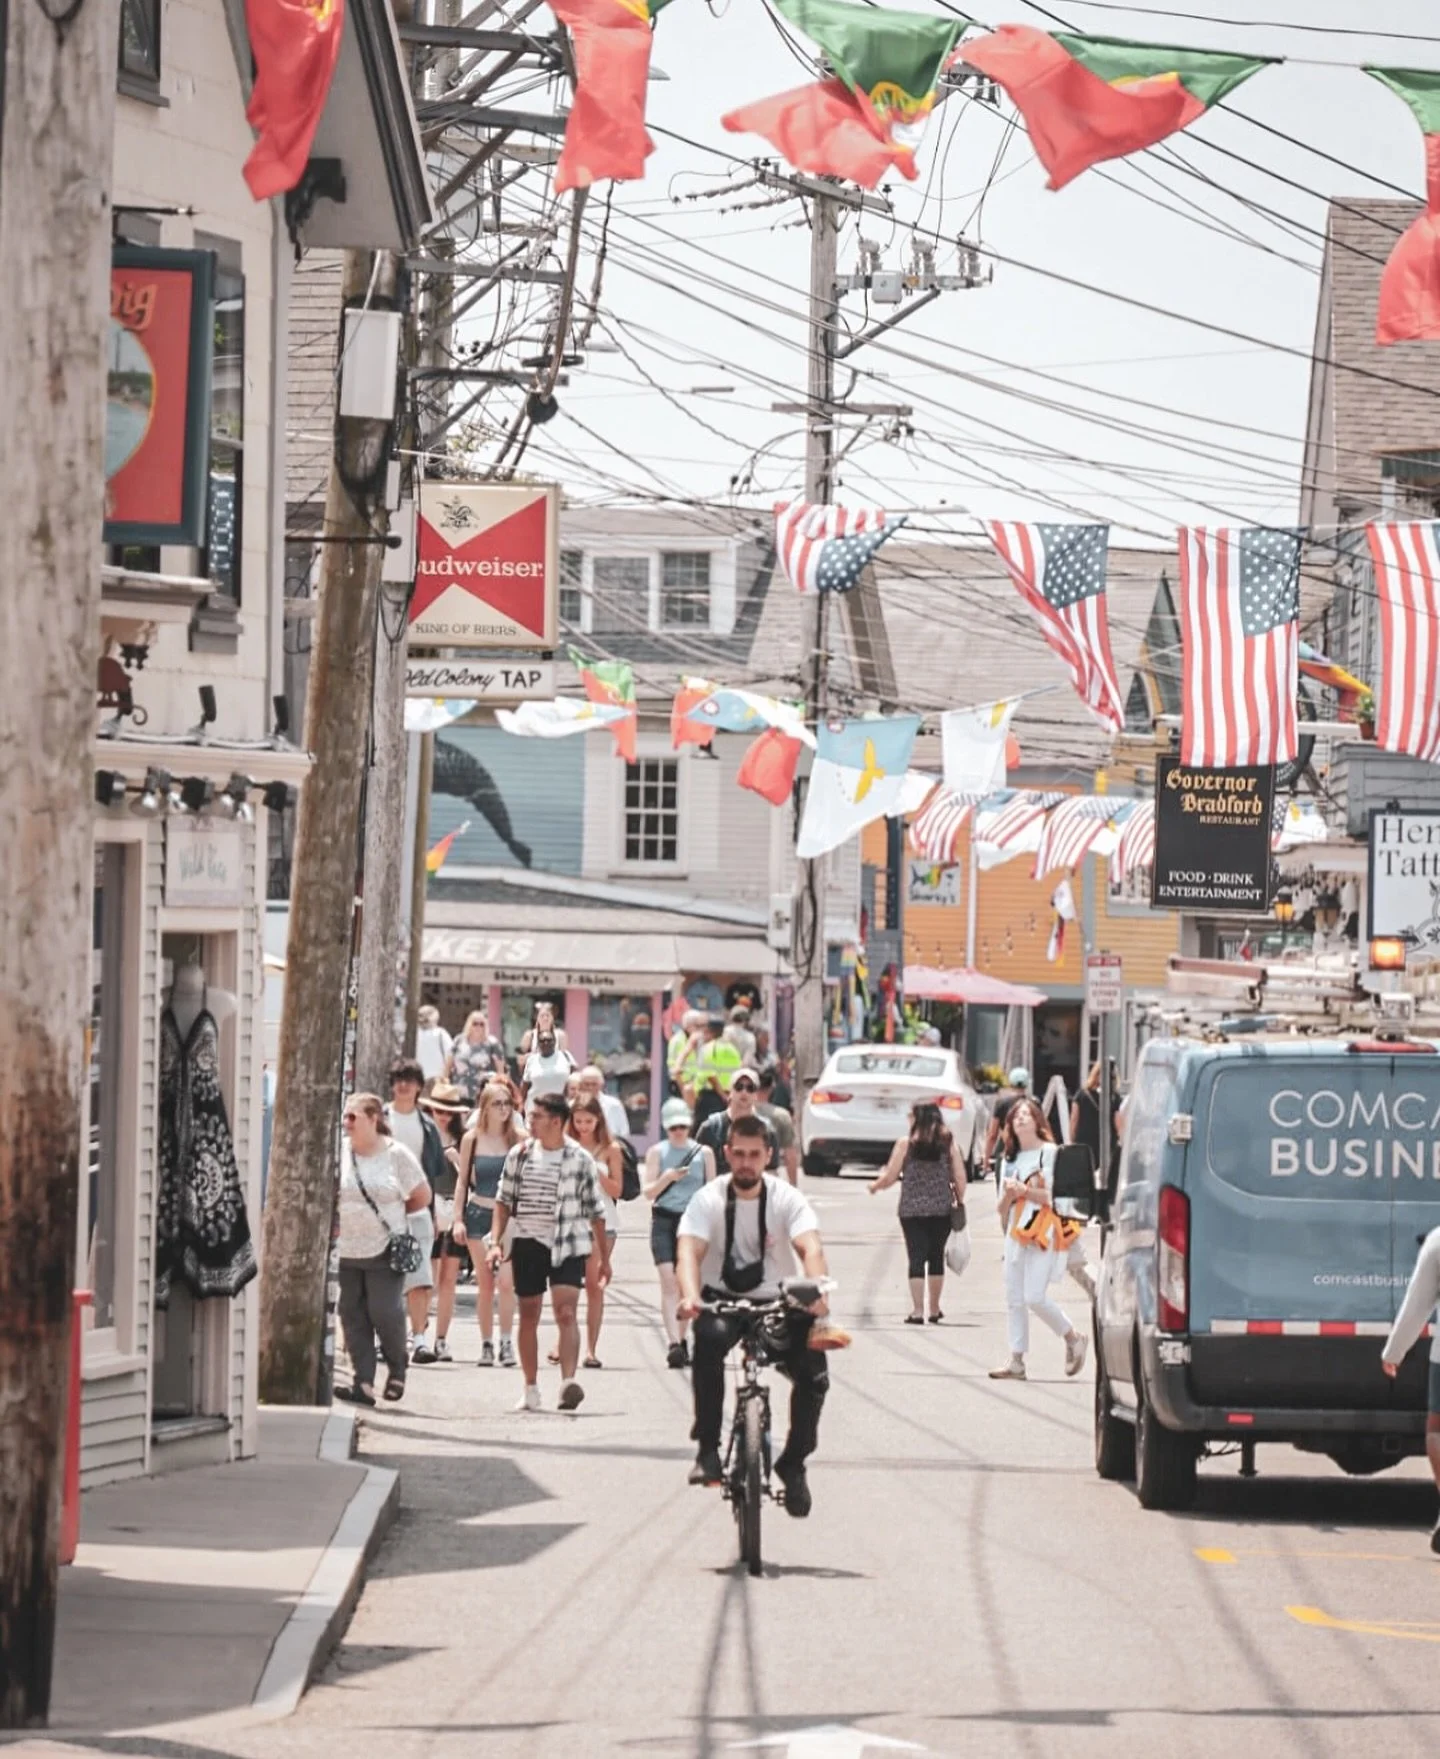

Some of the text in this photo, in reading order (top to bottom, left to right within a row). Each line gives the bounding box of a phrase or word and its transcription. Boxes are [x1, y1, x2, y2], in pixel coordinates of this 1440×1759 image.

[415, 622, 517, 636] KING OF BEERS
[434, 667, 495, 692] Colony
[499, 670, 543, 689] TAP
[1165, 766, 1257, 793] Governor
[1181, 792, 1263, 815] Bradford
[1199, 815, 1260, 825] RESTAURANT
[1168, 870, 1254, 885] FOOD DRINK
[1159, 884, 1263, 900] ENTERTAINMENT
[1269, 1089, 1440, 1131] COMC
